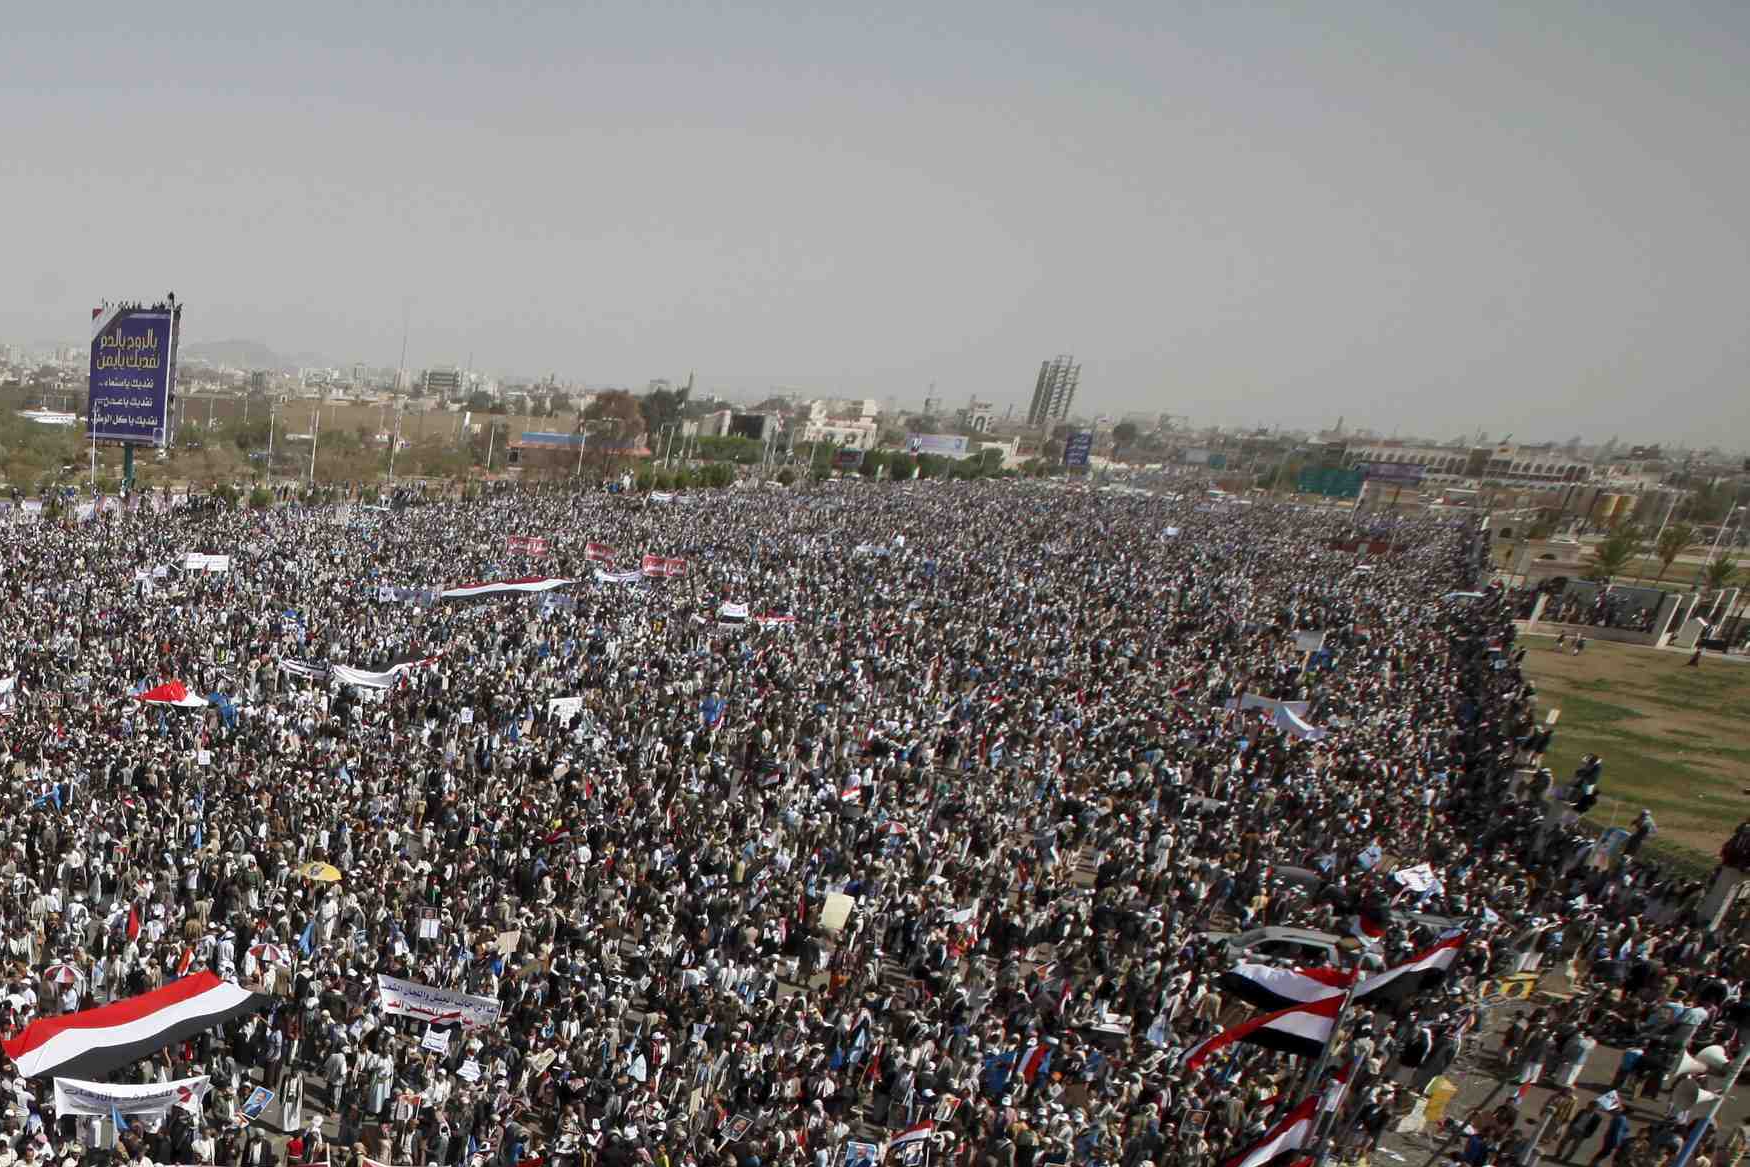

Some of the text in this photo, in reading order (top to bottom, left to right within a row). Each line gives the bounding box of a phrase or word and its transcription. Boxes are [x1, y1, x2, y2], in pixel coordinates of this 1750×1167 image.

[100, 327, 158, 350] بالروح بالدم
[126, 350, 160, 371] نفديك
